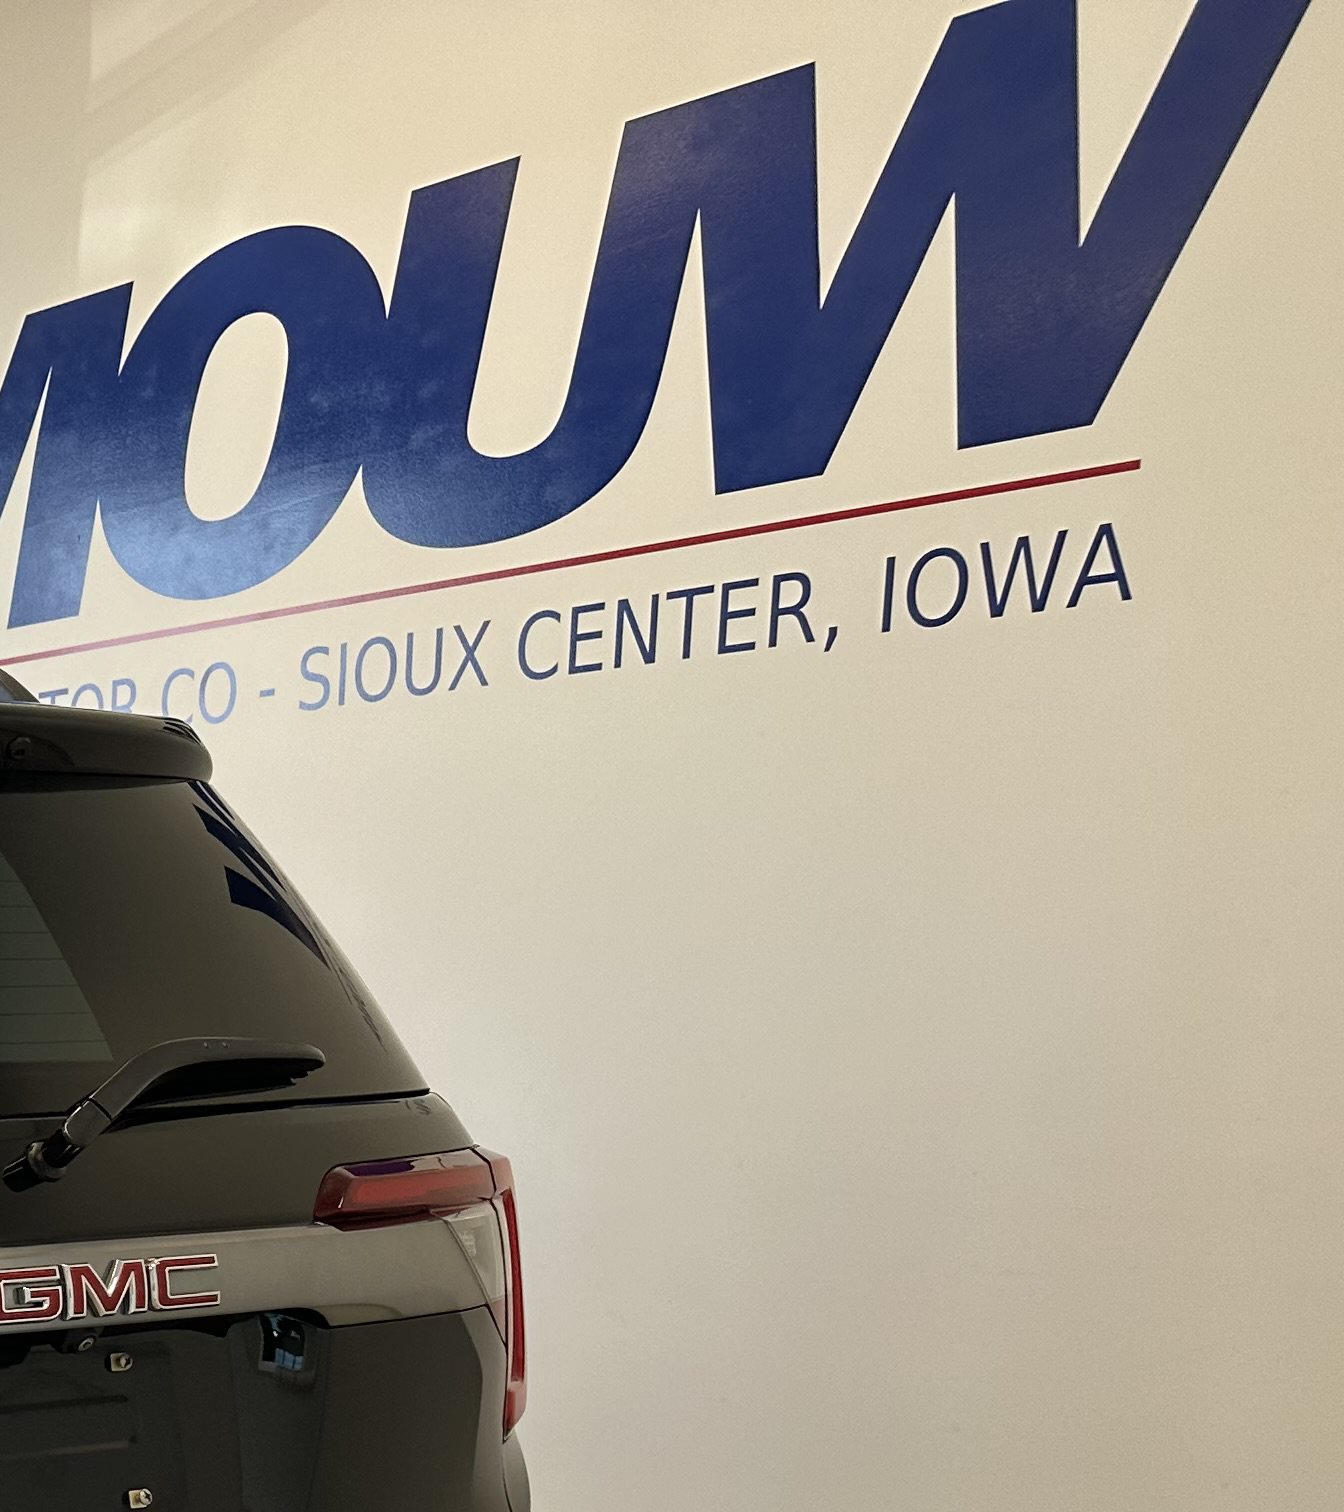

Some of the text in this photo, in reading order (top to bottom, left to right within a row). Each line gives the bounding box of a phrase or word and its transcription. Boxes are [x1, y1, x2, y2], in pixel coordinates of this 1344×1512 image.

[161, 661, 238, 725] CO
[298, 619, 492, 712] SIOUX
[517, 571, 839, 682] CENTER,
[880, 522, 1133, 634] IOWA
